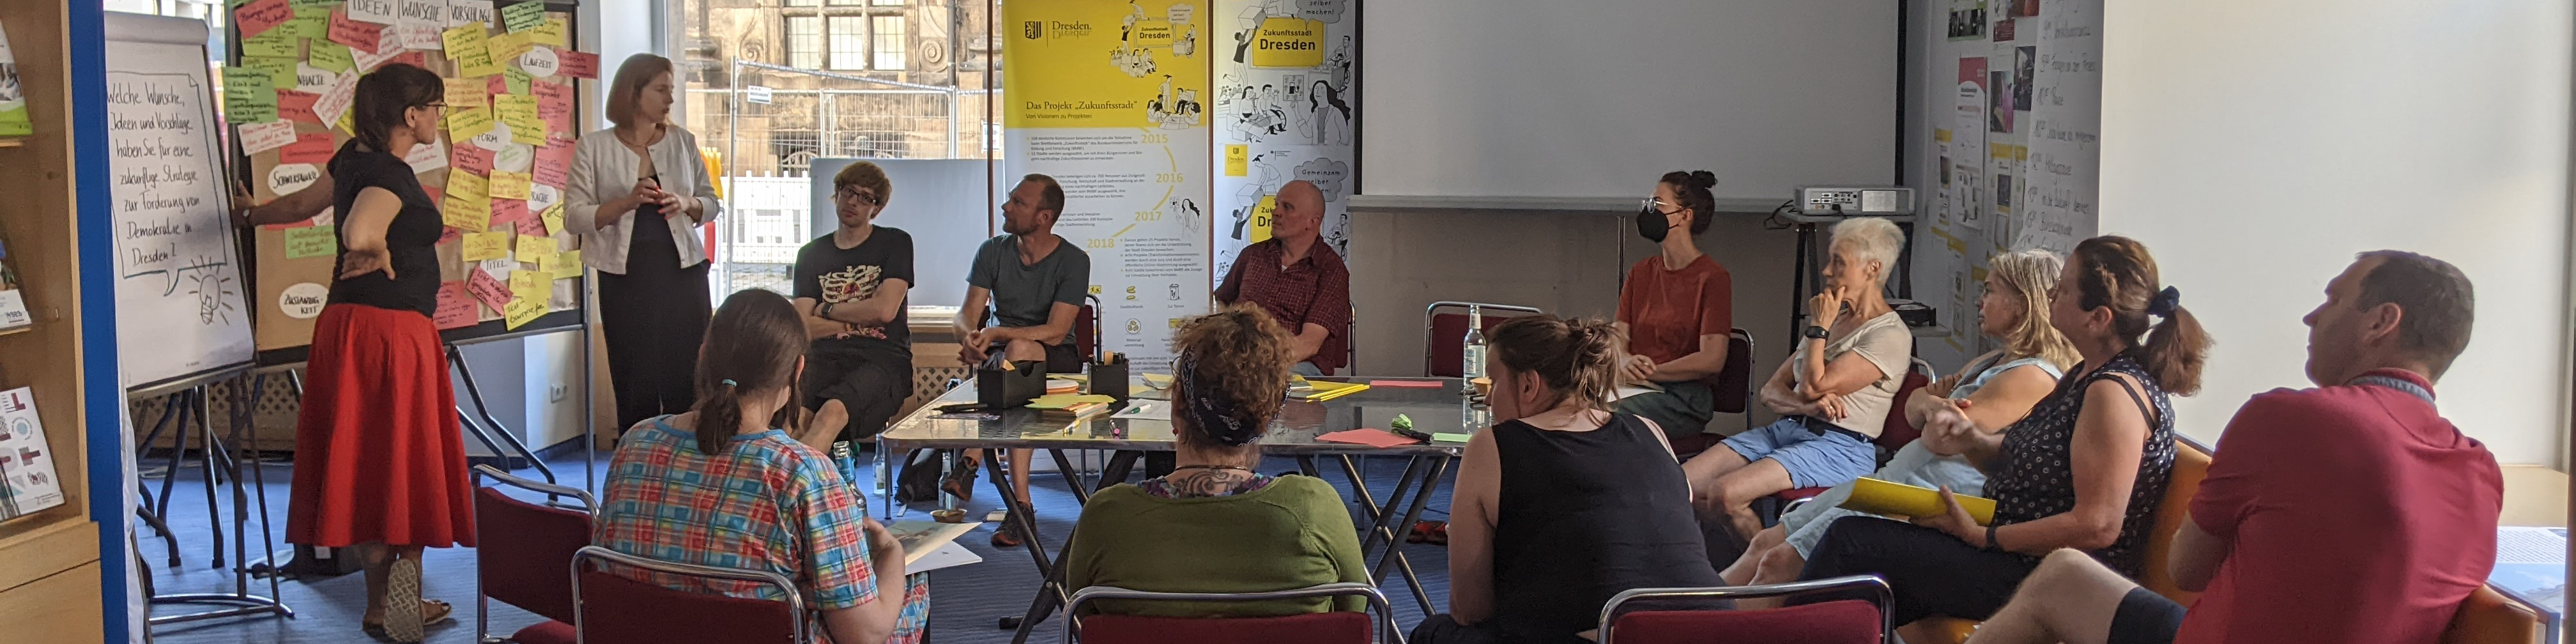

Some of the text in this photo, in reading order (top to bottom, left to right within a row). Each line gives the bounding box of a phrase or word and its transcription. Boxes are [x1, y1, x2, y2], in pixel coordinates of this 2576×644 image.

[1052, 20, 1092, 30] Dresden.
[1260, 39, 1315, 50] Dresden
[108, 82, 142, 106] Welche
[1026, 101, 1041, 110] Das
[1044, 101, 1073, 111] Projekt
[140, 116, 155, 130] und
[1140, 134, 1169, 144] 2015
[116, 137, 142, 159] haben
[1155, 173, 1184, 183] 2016
[124, 199, 139, 213] zur
[1135, 211, 1162, 222] 2017
[126, 216, 182, 240] Demokratie
[1087, 238, 1115, 249] 2018
